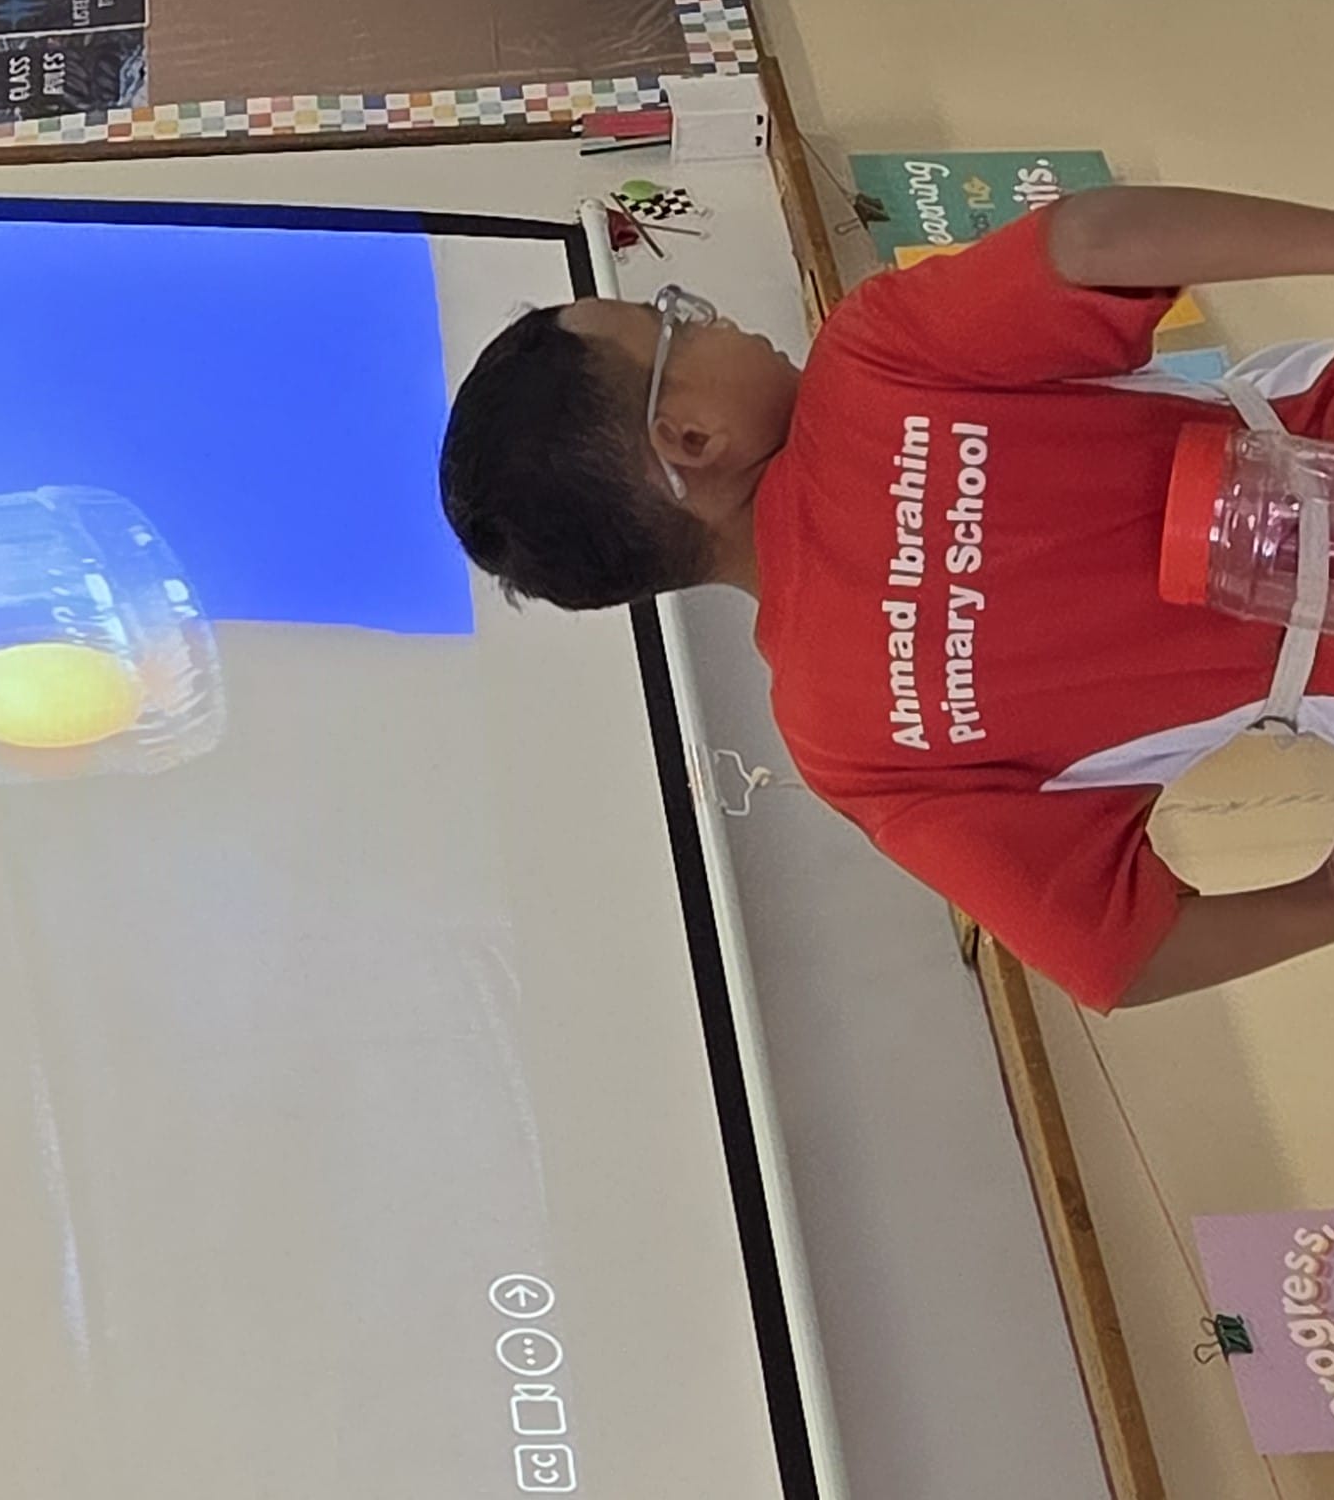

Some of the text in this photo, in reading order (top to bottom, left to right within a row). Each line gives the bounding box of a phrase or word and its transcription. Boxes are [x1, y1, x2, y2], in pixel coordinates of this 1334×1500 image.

[8, 56, 31, 100] CLASS
[43, 52, 65, 95] RULES
[903, 161, 954, 246] earning
[882, 415, 931, 750] Ahmad Ibrahim
[941, 422, 989, 744] Primary School
[531, 1453, 559, 1484] CC
